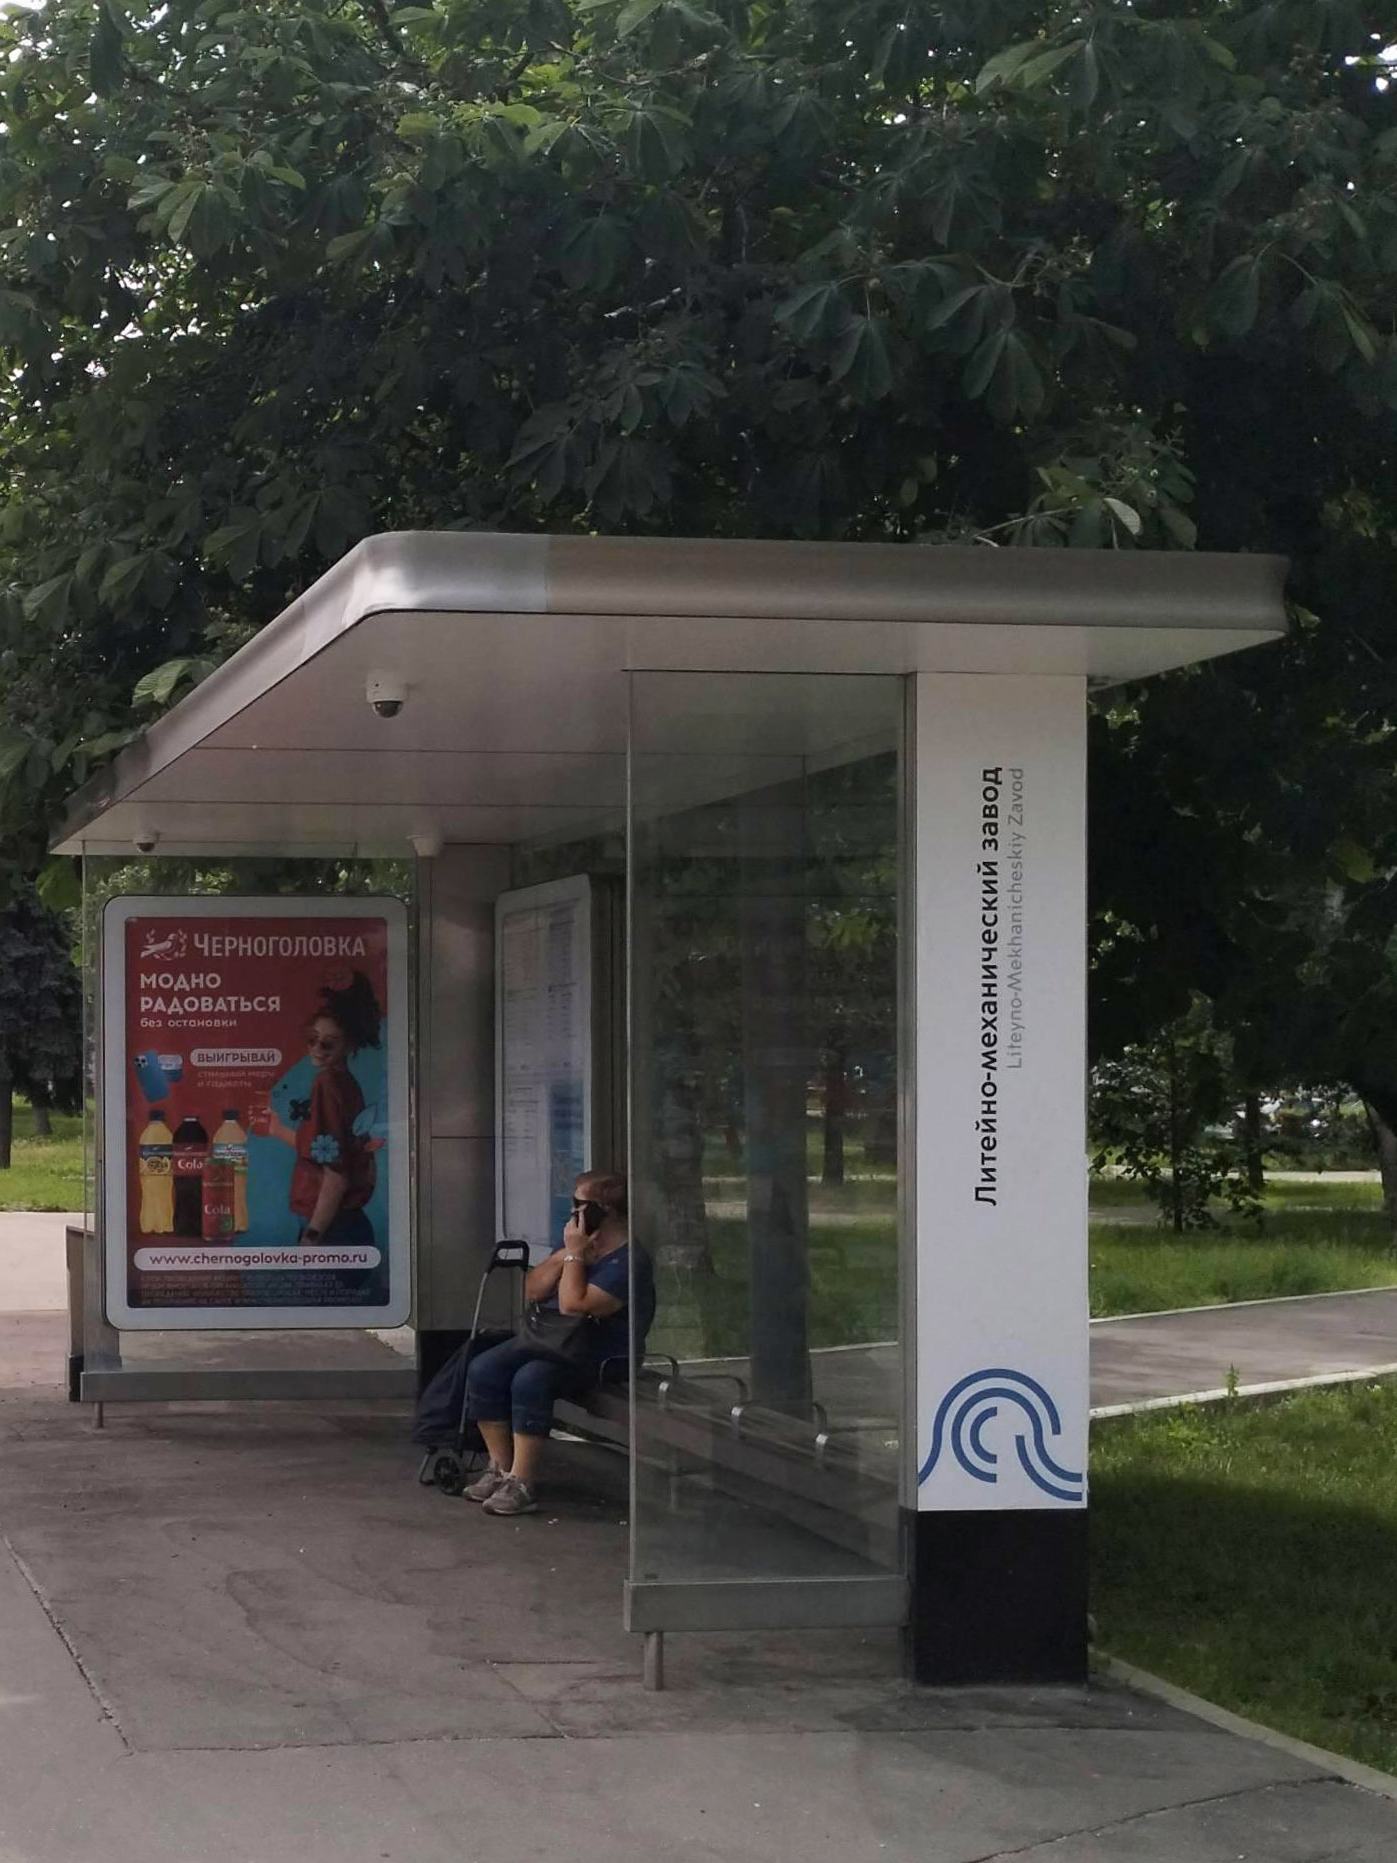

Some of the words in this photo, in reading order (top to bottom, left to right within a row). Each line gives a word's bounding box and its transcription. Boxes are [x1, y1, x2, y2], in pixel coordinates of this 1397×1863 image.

[1007, 767, 1023, 826] Zavod
[981, 766, 1002, 851] завод
[194, 933, 366, 957] ЧЕРНОГОЛОВКА
[1006, 834, 1026, 1069] Liteyno-Mekhanicheskiy
[139, 972, 221, 991] МОДНО
[139, 995, 281, 1015] РАДОВАТЬСЯ
[139, 1017, 163, 1028] без
[167, 1018, 237, 1028] остановки
[974, 860, 998, 1207] Литейно-механический
[197, 1051, 276, 1063] ВЫИГРЫВАЙ
[177, 1158, 203, 1170] Cola
[204, 1204, 231, 1215] Cola
[149, 1251, 368, 1267] www.chernogolovka-promo.ru
